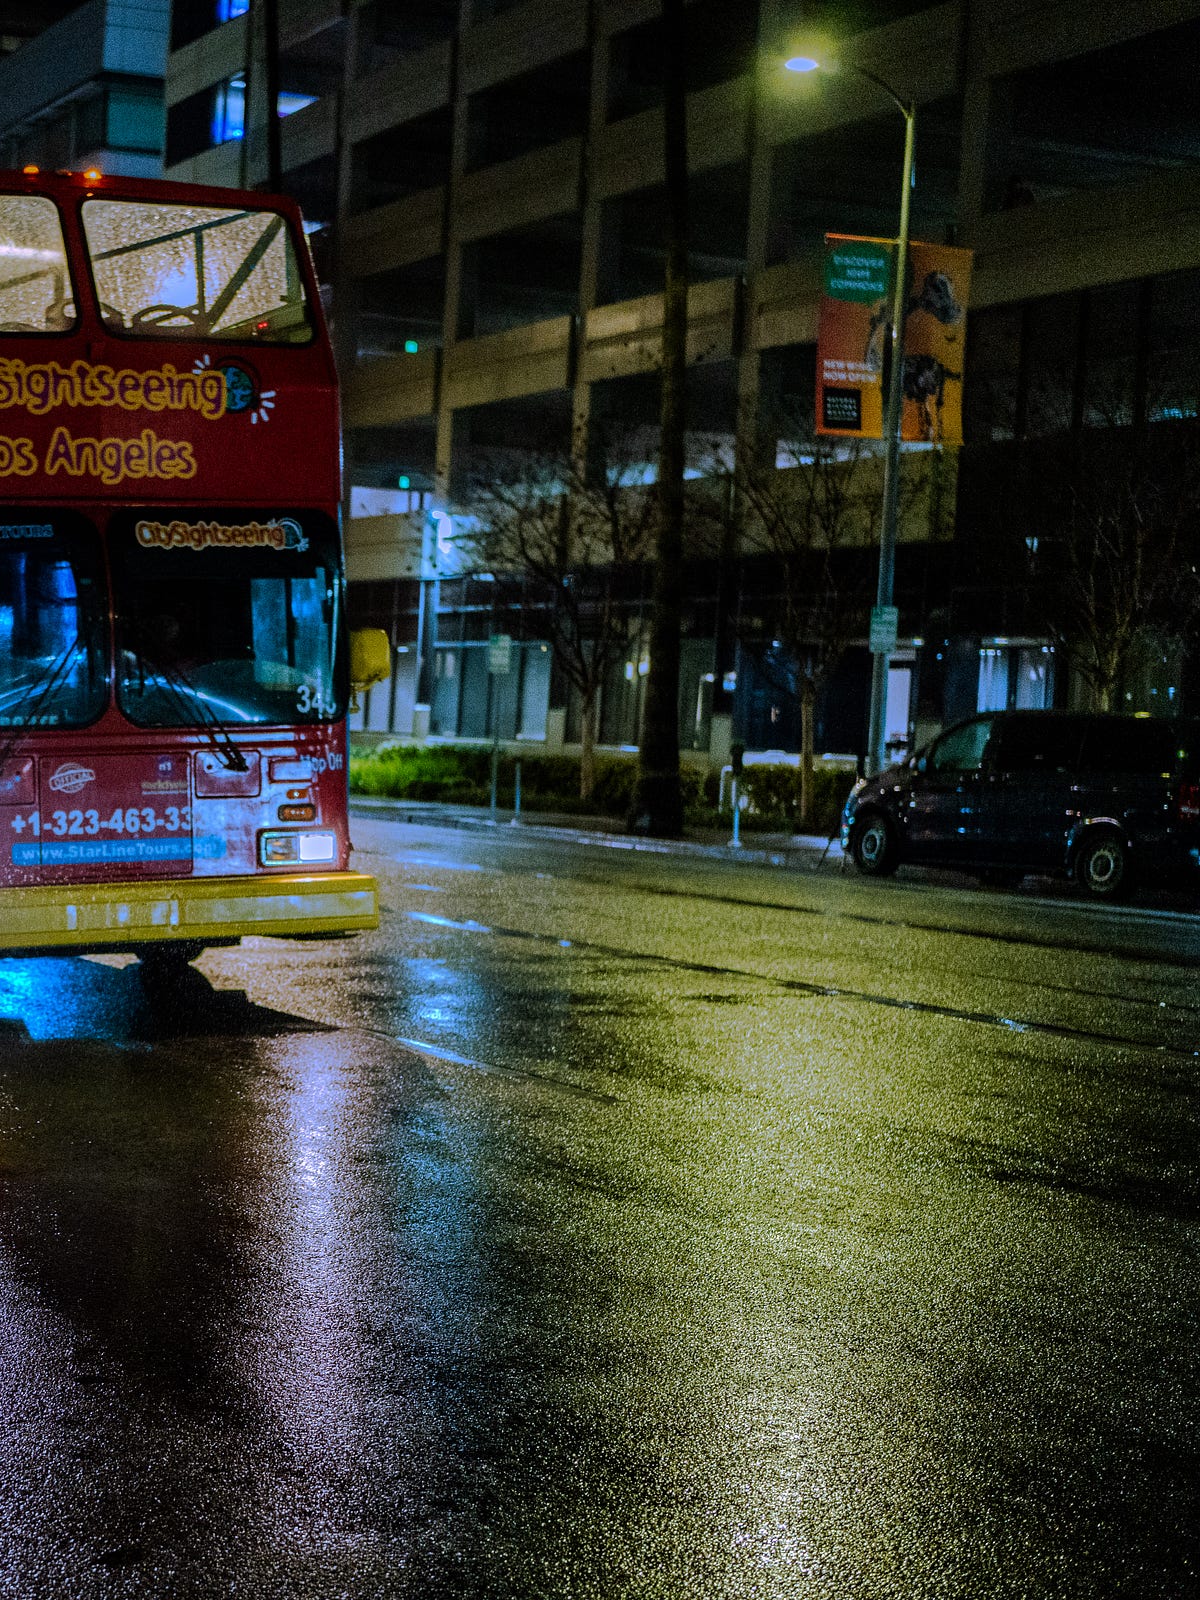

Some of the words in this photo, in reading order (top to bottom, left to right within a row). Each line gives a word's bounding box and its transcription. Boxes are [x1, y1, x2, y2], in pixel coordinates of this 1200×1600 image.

[45, 426, 198, 485] Angeles
[0, 524, 55, 539] TOURS
[135, 519, 286, 552] CitySightseeing
[327, 752, 343, 772] Off
[52, 770, 93, 789] OFFICIAL
[10, 806, 226, 837] +1-323-463-33
